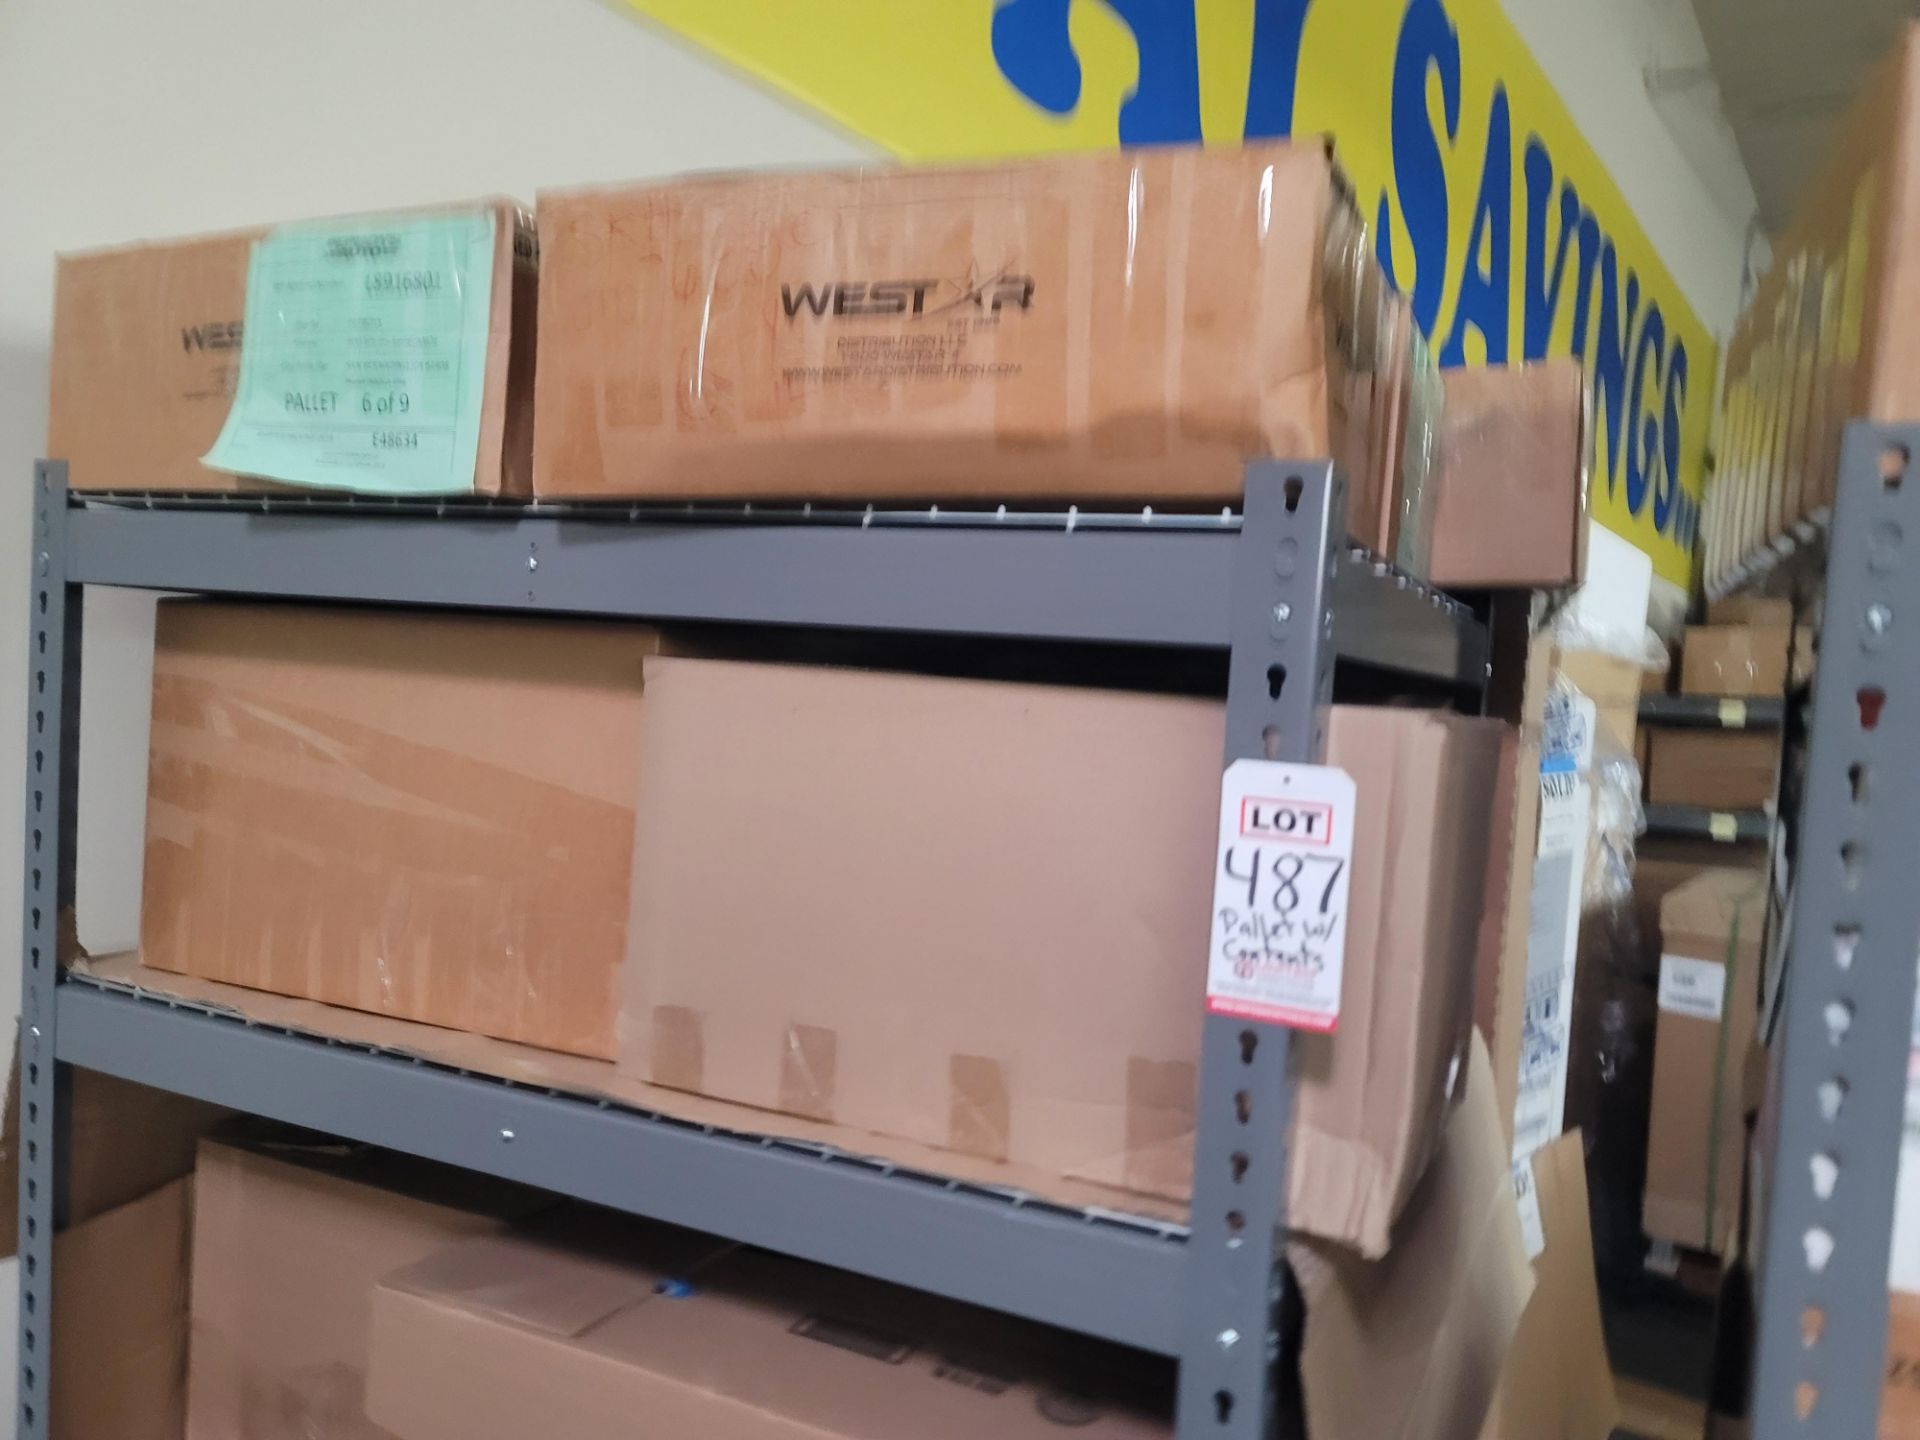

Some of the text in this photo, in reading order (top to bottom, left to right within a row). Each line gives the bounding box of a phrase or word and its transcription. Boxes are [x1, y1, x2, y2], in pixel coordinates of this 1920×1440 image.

[285, 390, 410, 413] PALLET 6 of 9
[1252, 806, 1322, 834] LOT
[1225, 847, 1344, 914] 487
